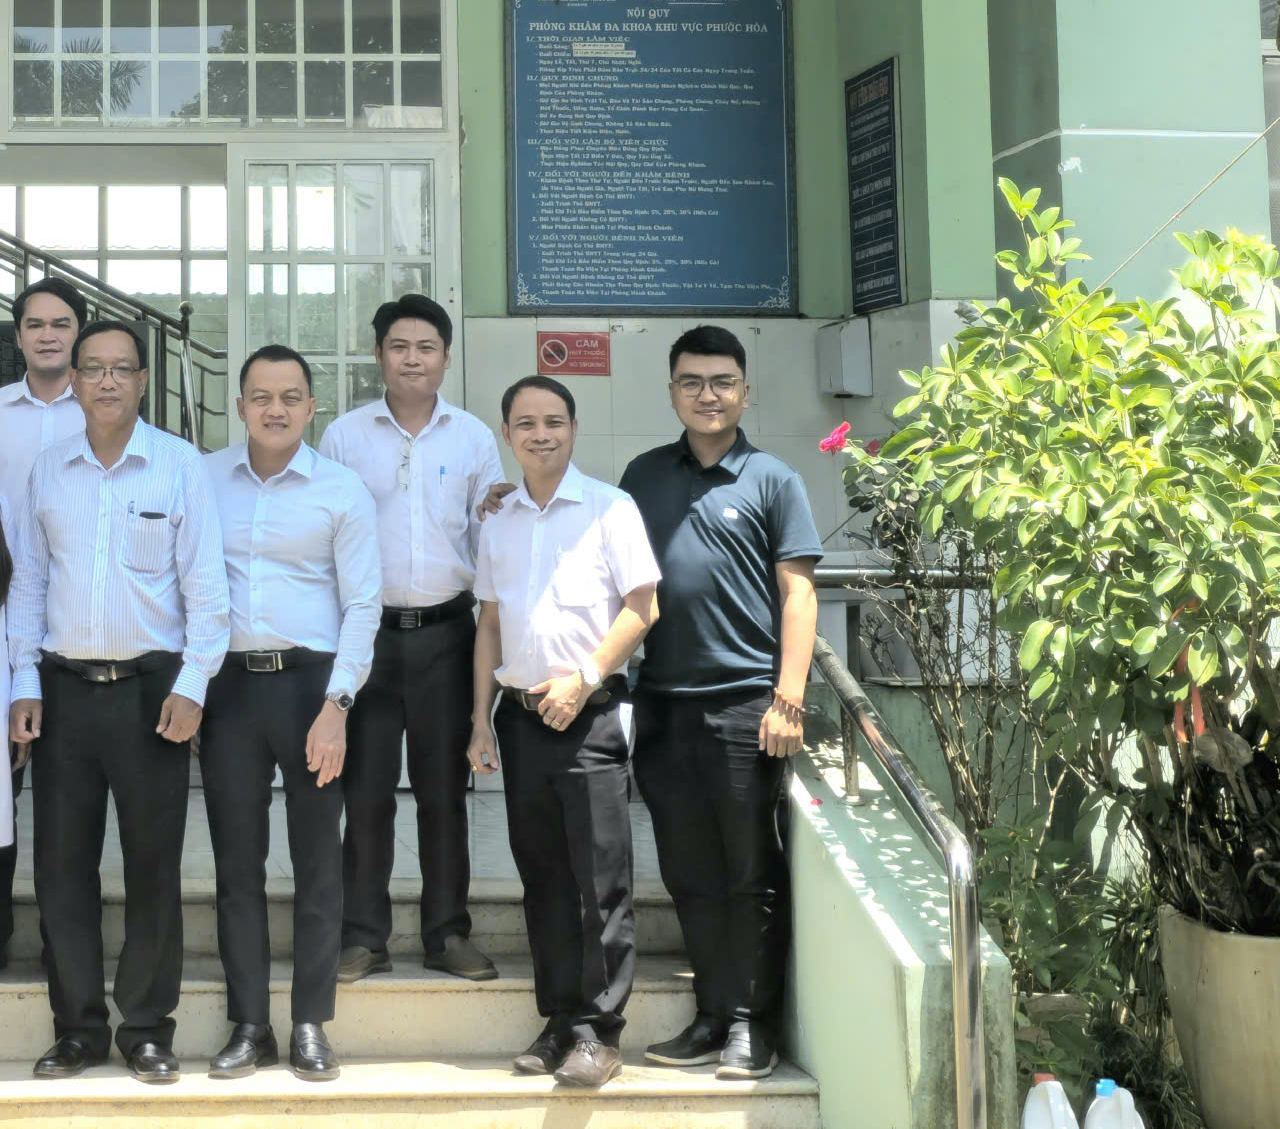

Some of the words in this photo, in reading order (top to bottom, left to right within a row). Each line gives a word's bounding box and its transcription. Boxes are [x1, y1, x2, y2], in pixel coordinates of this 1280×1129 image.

[627, 7, 645, 19] NỘI
[648, 8, 671, 19] QUY
[529, 19, 566, 31] PHÒNG
[604, 22, 620, 31] ĐA
[622, 22, 653, 32] KHOA
[655, 22, 678, 31] KHU
[745, 22, 769, 32] HÒA
